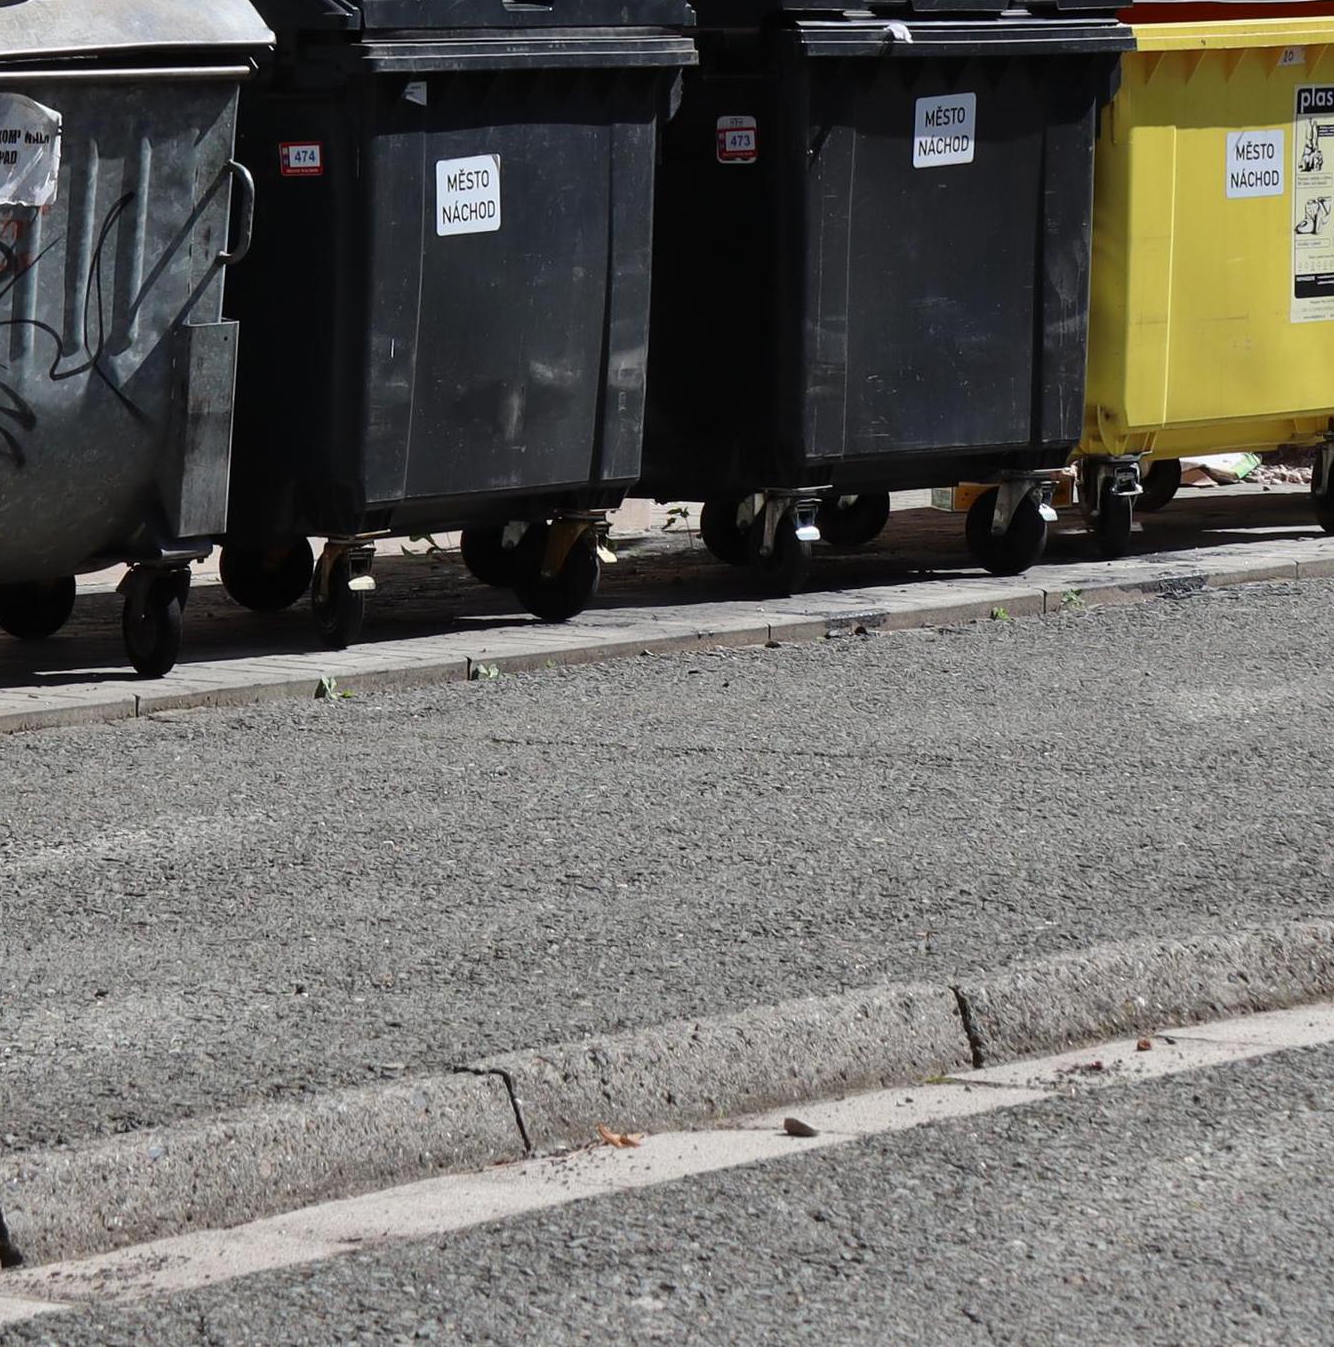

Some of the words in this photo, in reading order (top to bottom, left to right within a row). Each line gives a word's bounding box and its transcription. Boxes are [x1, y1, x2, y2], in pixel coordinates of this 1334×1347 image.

[925, 106, 965, 128] MĚSTO
[731, 135, 751, 146] 473
[918, 134, 969, 157] NÁCHOD
[1235, 141, 1275, 160] MĚSTO
[294, 150, 315, 163] 474
[447, 169, 490, 193] MĚSTO
[1230, 168, 1280, 188] NÁCHOD
[442, 200, 496, 224] NÁCHOD
